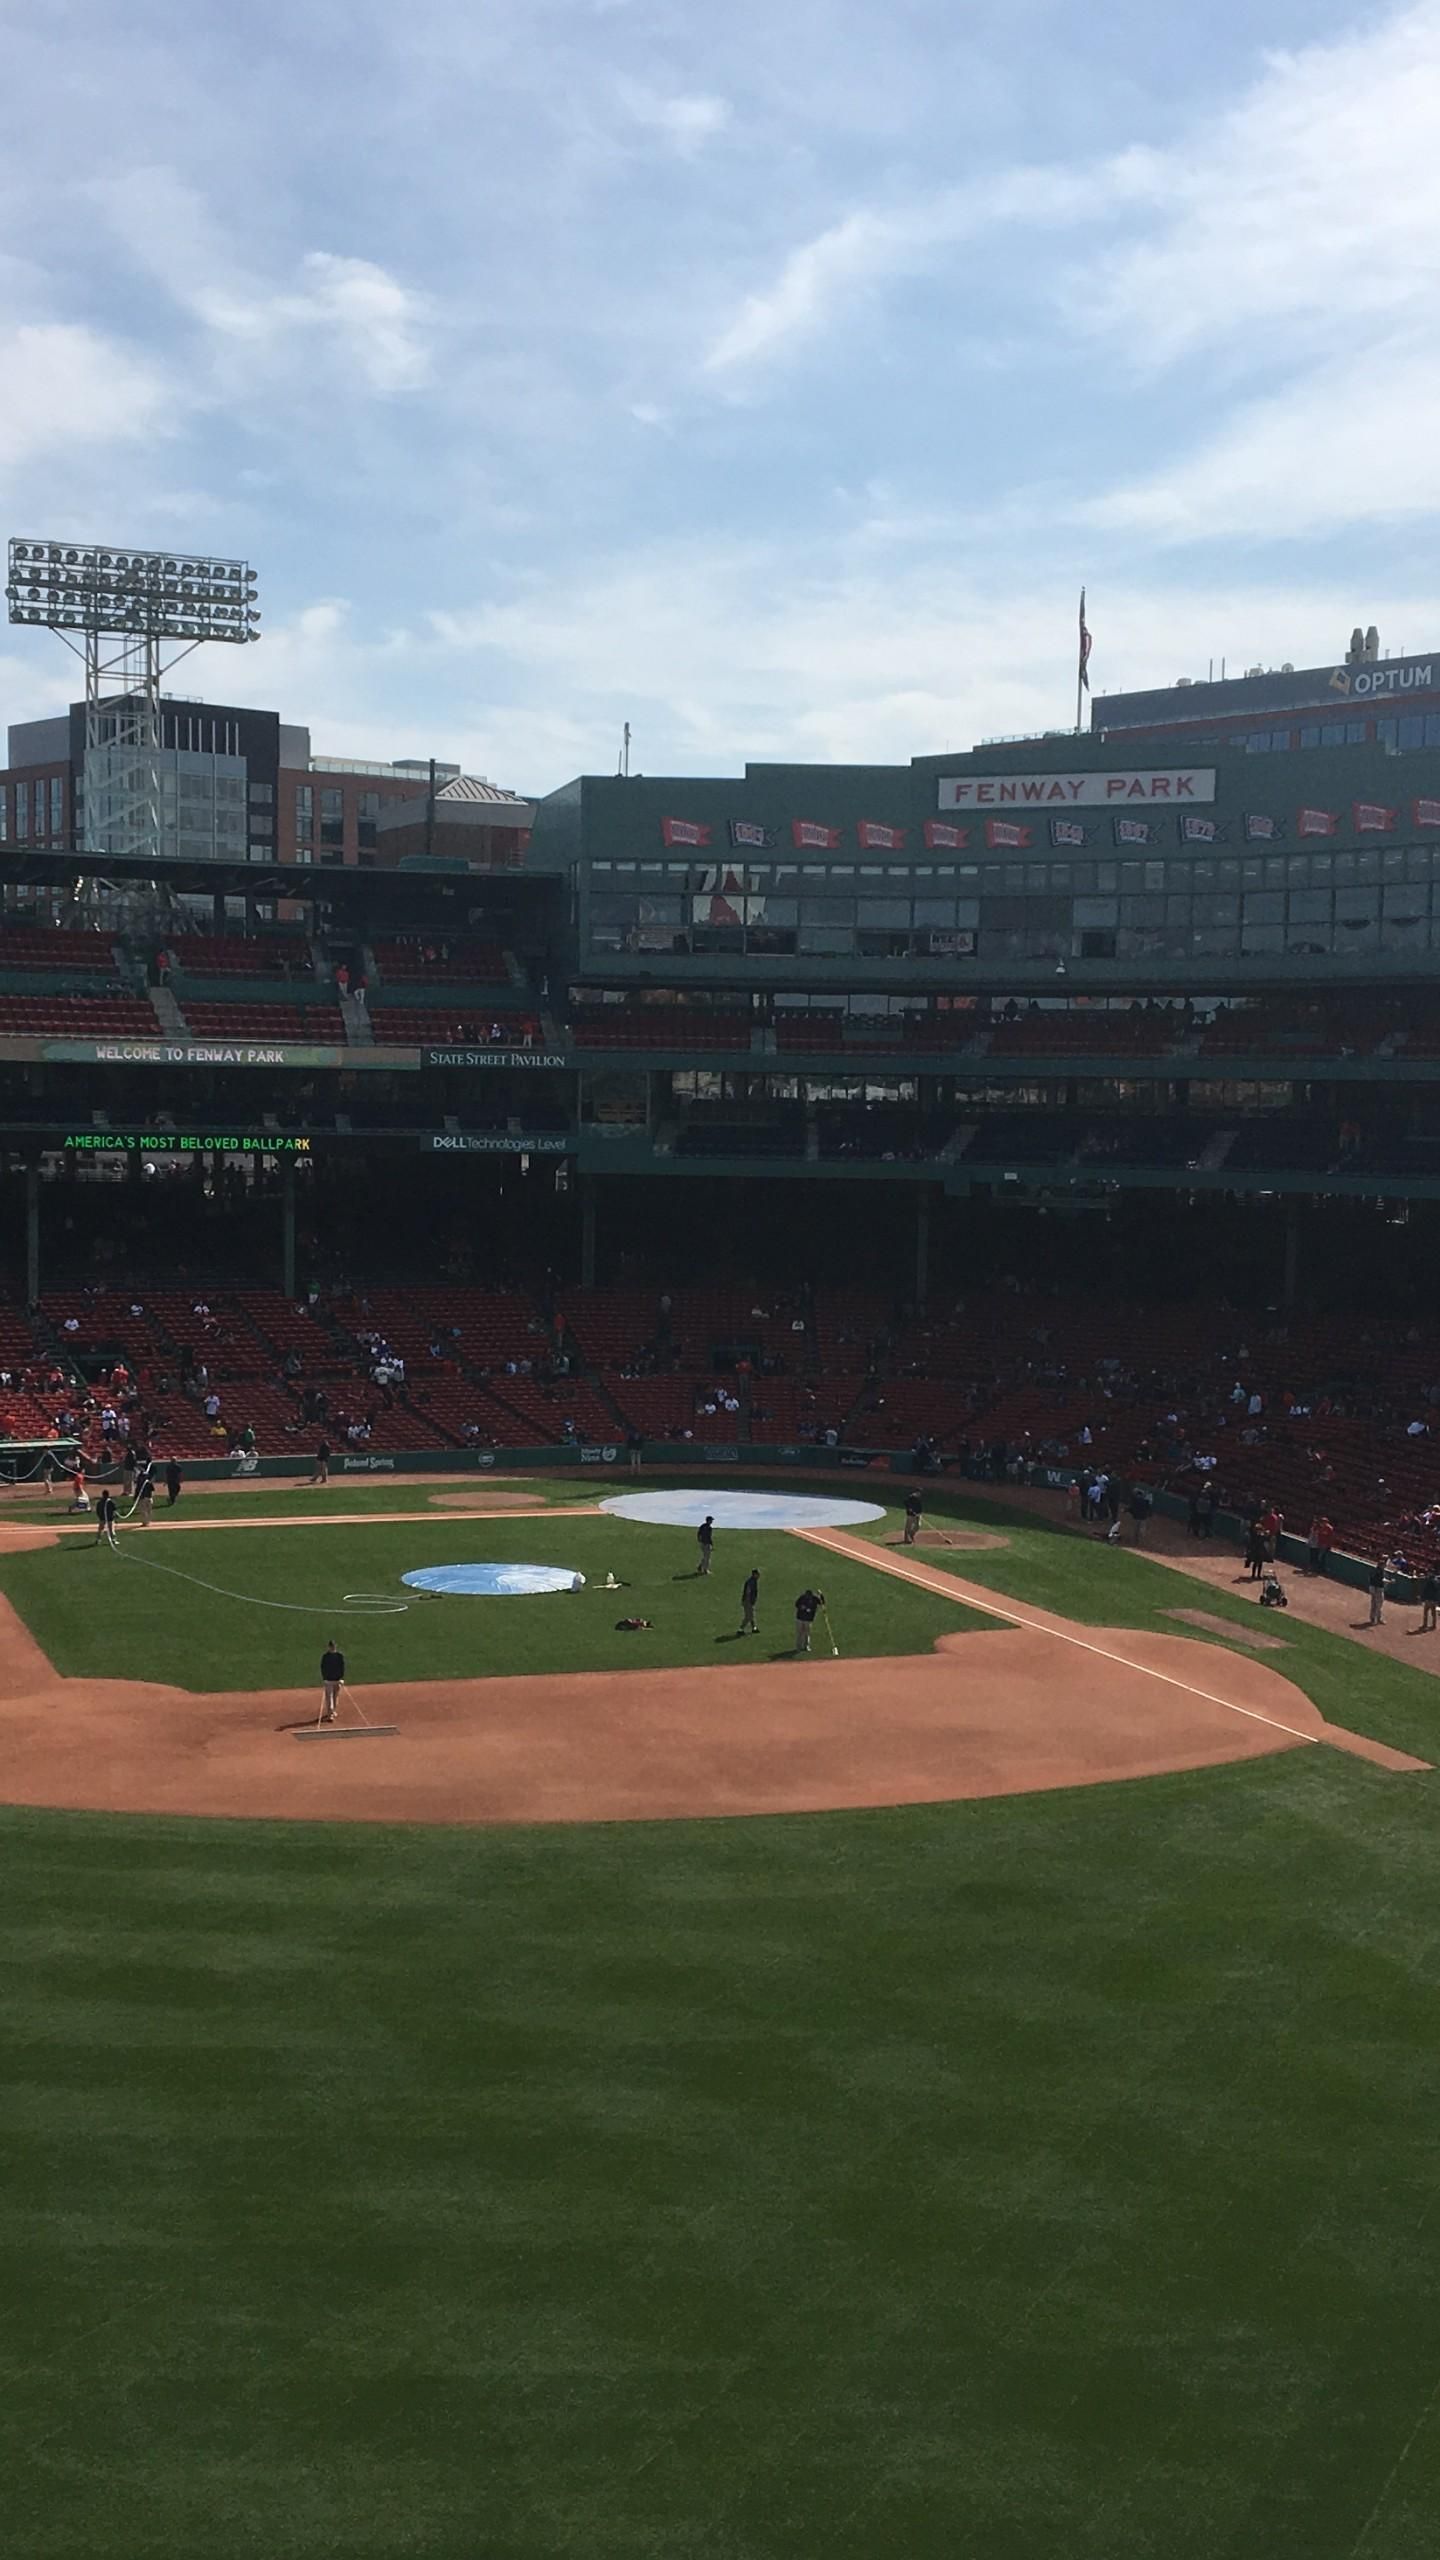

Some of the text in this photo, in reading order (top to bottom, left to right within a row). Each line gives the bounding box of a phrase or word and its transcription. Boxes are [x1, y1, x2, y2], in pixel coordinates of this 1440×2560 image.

[1354, 664, 1433, 694] OPTUM
[954, 775, 1195, 803] FENWAY PARK
[95, 1045, 284, 1063] WELCOME TO FENWAY PARK
[429, 1051, 566, 1067] STATE STREET PAVILION
[63, 1135, 311, 1150] AMERICA'S MOST BELOVED BALLPARK
[537, 1138, 567, 1150] Level
